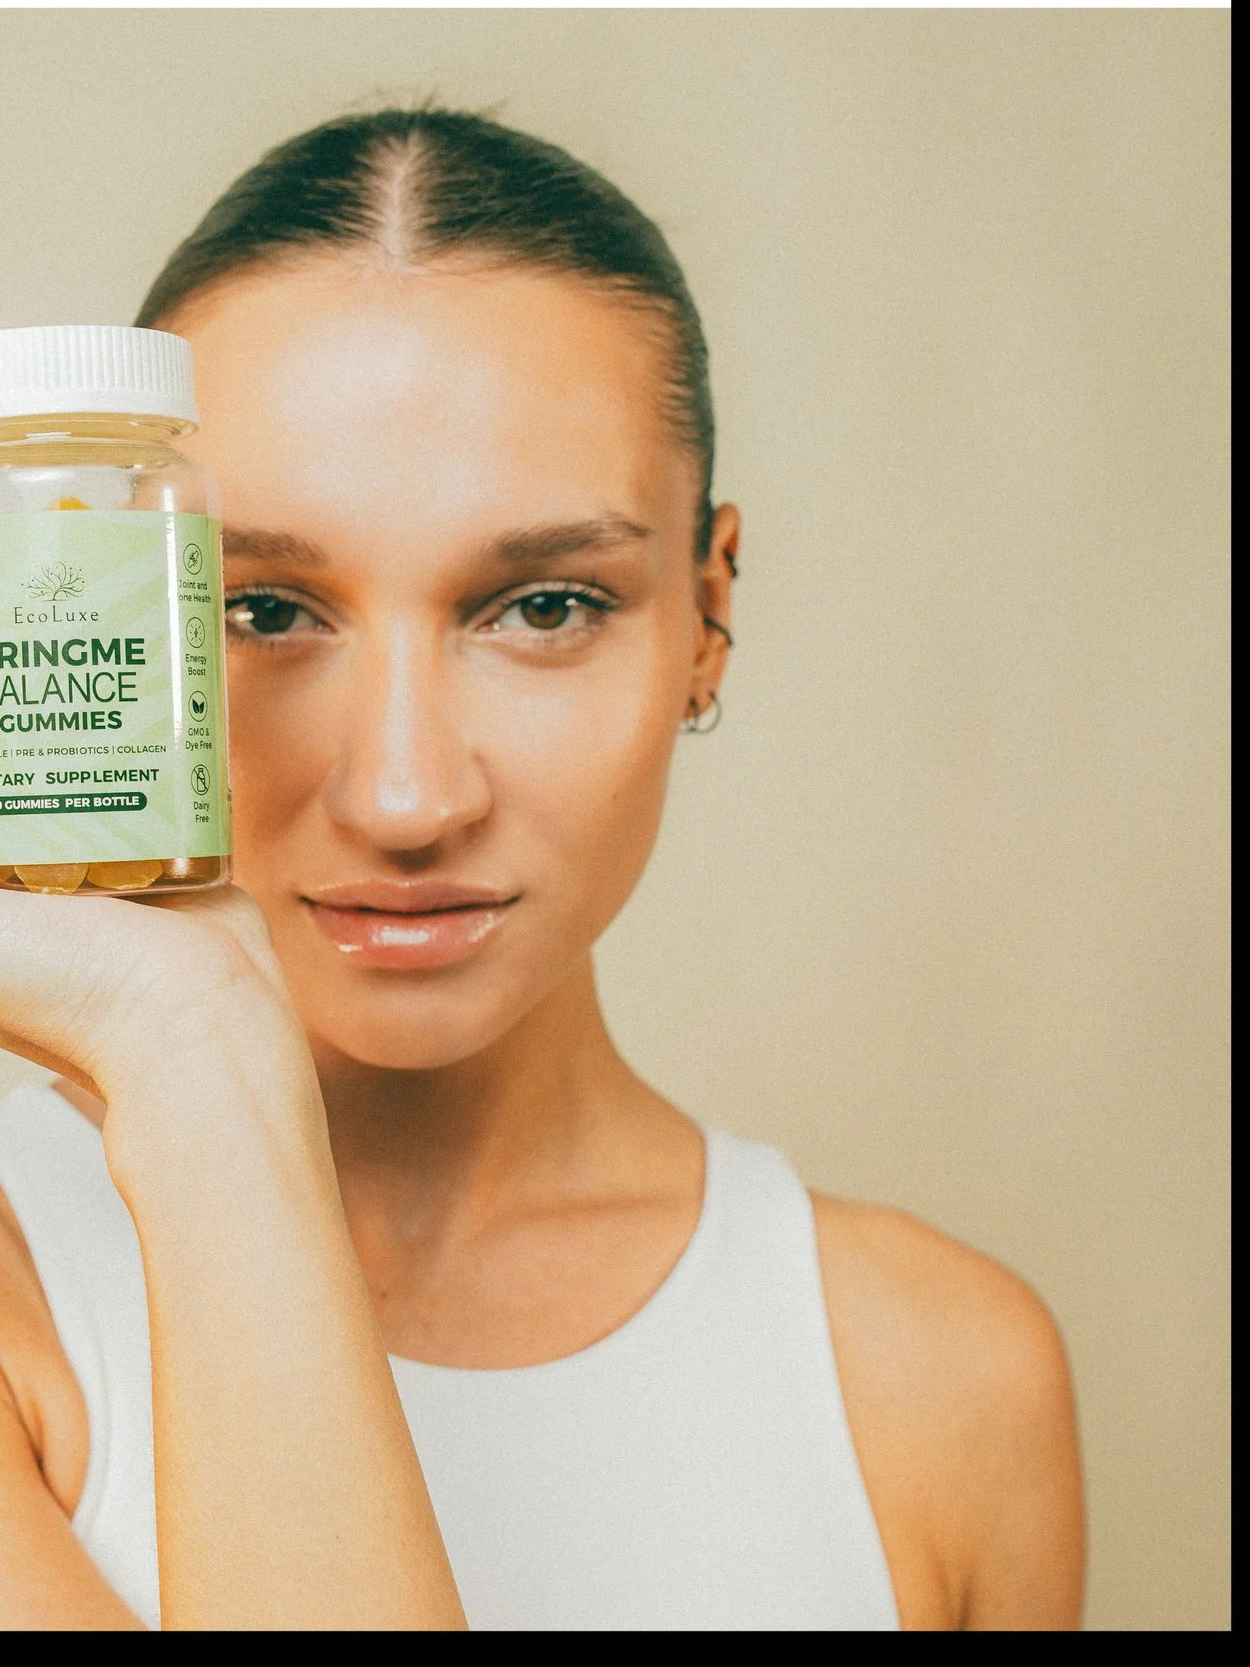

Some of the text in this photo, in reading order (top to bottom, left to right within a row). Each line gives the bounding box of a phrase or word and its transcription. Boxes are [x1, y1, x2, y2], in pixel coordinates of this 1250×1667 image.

[178, 579, 208, 590] Joint and
[178, 593, 211, 604] one Health
[14, 605, 100, 624] EcoLuxe
[185, 653, 207, 665] Energy
[187, 667, 207, 676] Boost
[0, 710, 123, 734] GUMMIES
[188, 728, 205, 736] GMO
[16, 748, 35, 757] PRE
[38, 748, 45, 757] &
[47, 746, 110, 756] PROBIOTICS
[117, 745, 167, 754] COLLAGEN
[185, 741, 212, 752] Dye Free
[45, 768, 160, 785] SUPPLEMENT
[4, 798, 60, 810] GUMMIES
[65, 797, 91, 808] PER
[93, 796, 140, 807] BOTTLE
[193, 801, 210, 811] Dairy
[195, 814, 209, 823] Free
